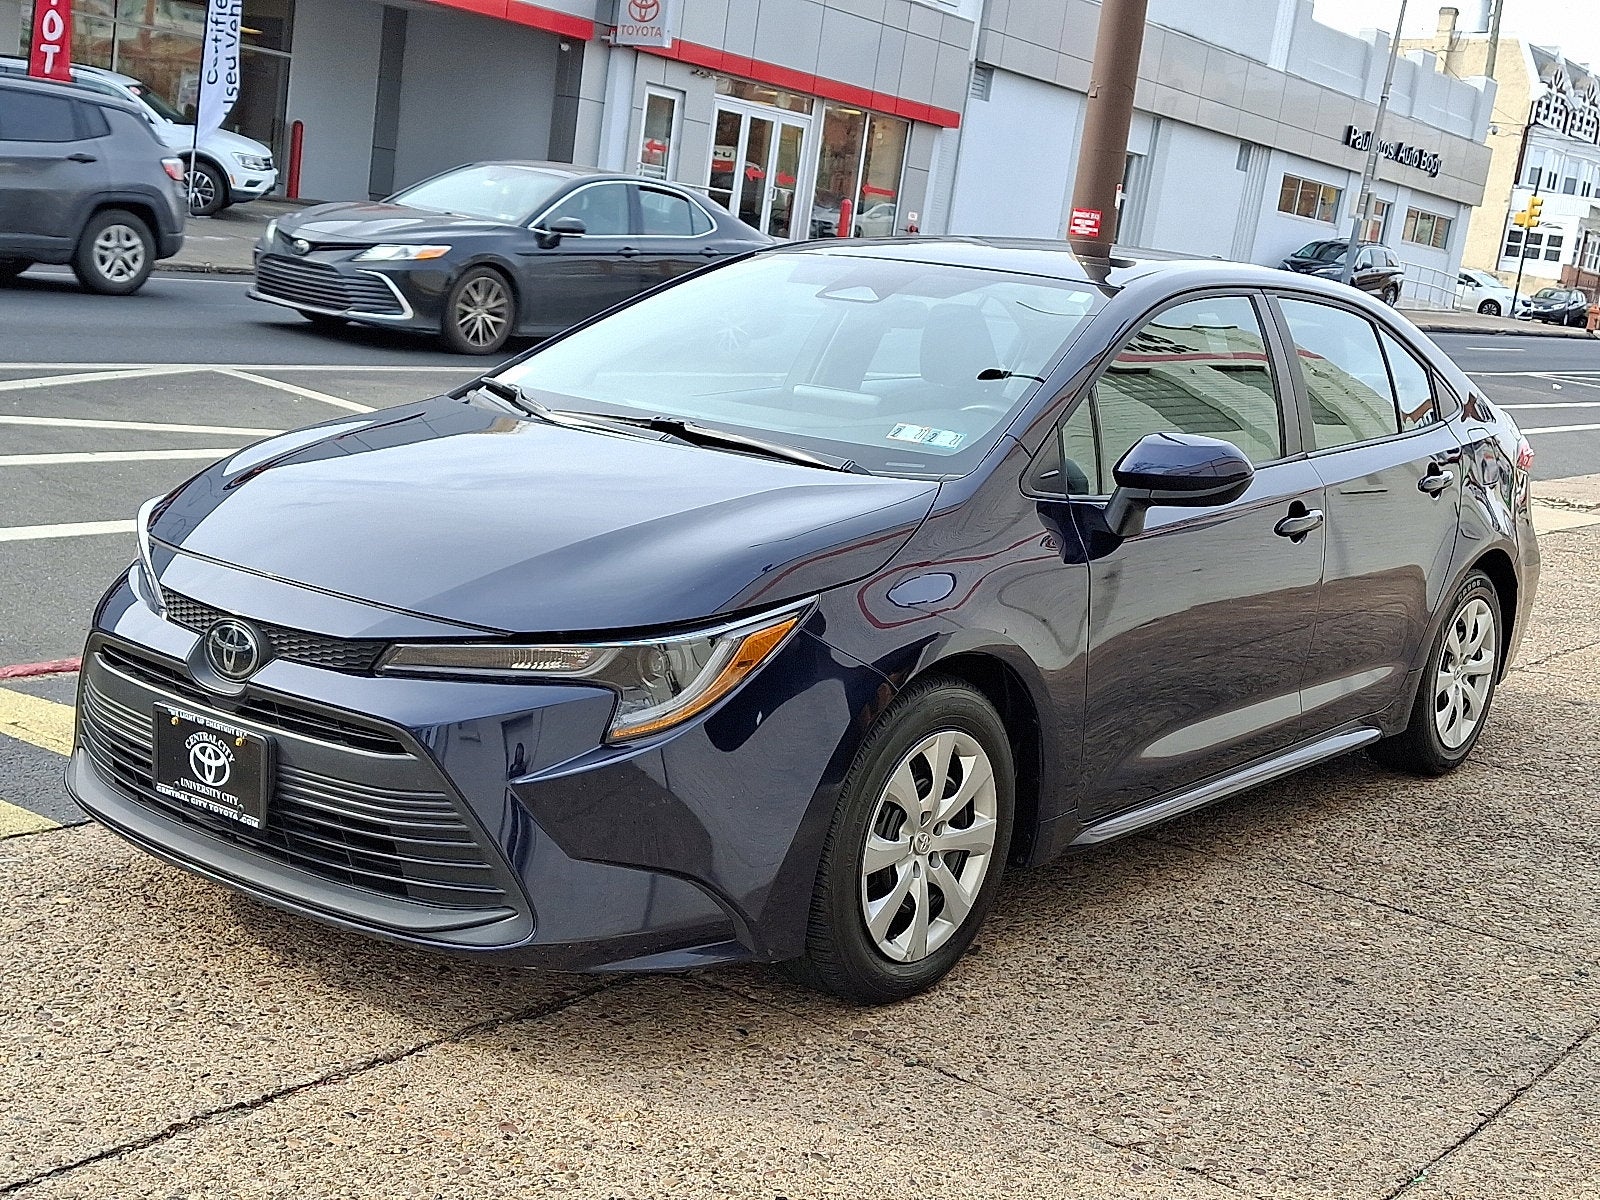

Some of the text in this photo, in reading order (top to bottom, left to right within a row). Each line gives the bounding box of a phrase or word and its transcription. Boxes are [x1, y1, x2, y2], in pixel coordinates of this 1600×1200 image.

[39, 0, 65, 75] OT
[620, 24, 663, 38] TOYOTA
[1376, 139, 1396, 160] ros.
[1397, 142, 1420, 168] Auto
[1420, 149, 1442, 178] Body
[185, 731, 236, 762] CENTRAL CITY
[156, 785, 190, 803] CENTRAL
[190, 796, 207, 809] CITY
[208, 803, 239, 821] TOYOTA
[180, 777, 239, 806] UNIVERSITY CITY
